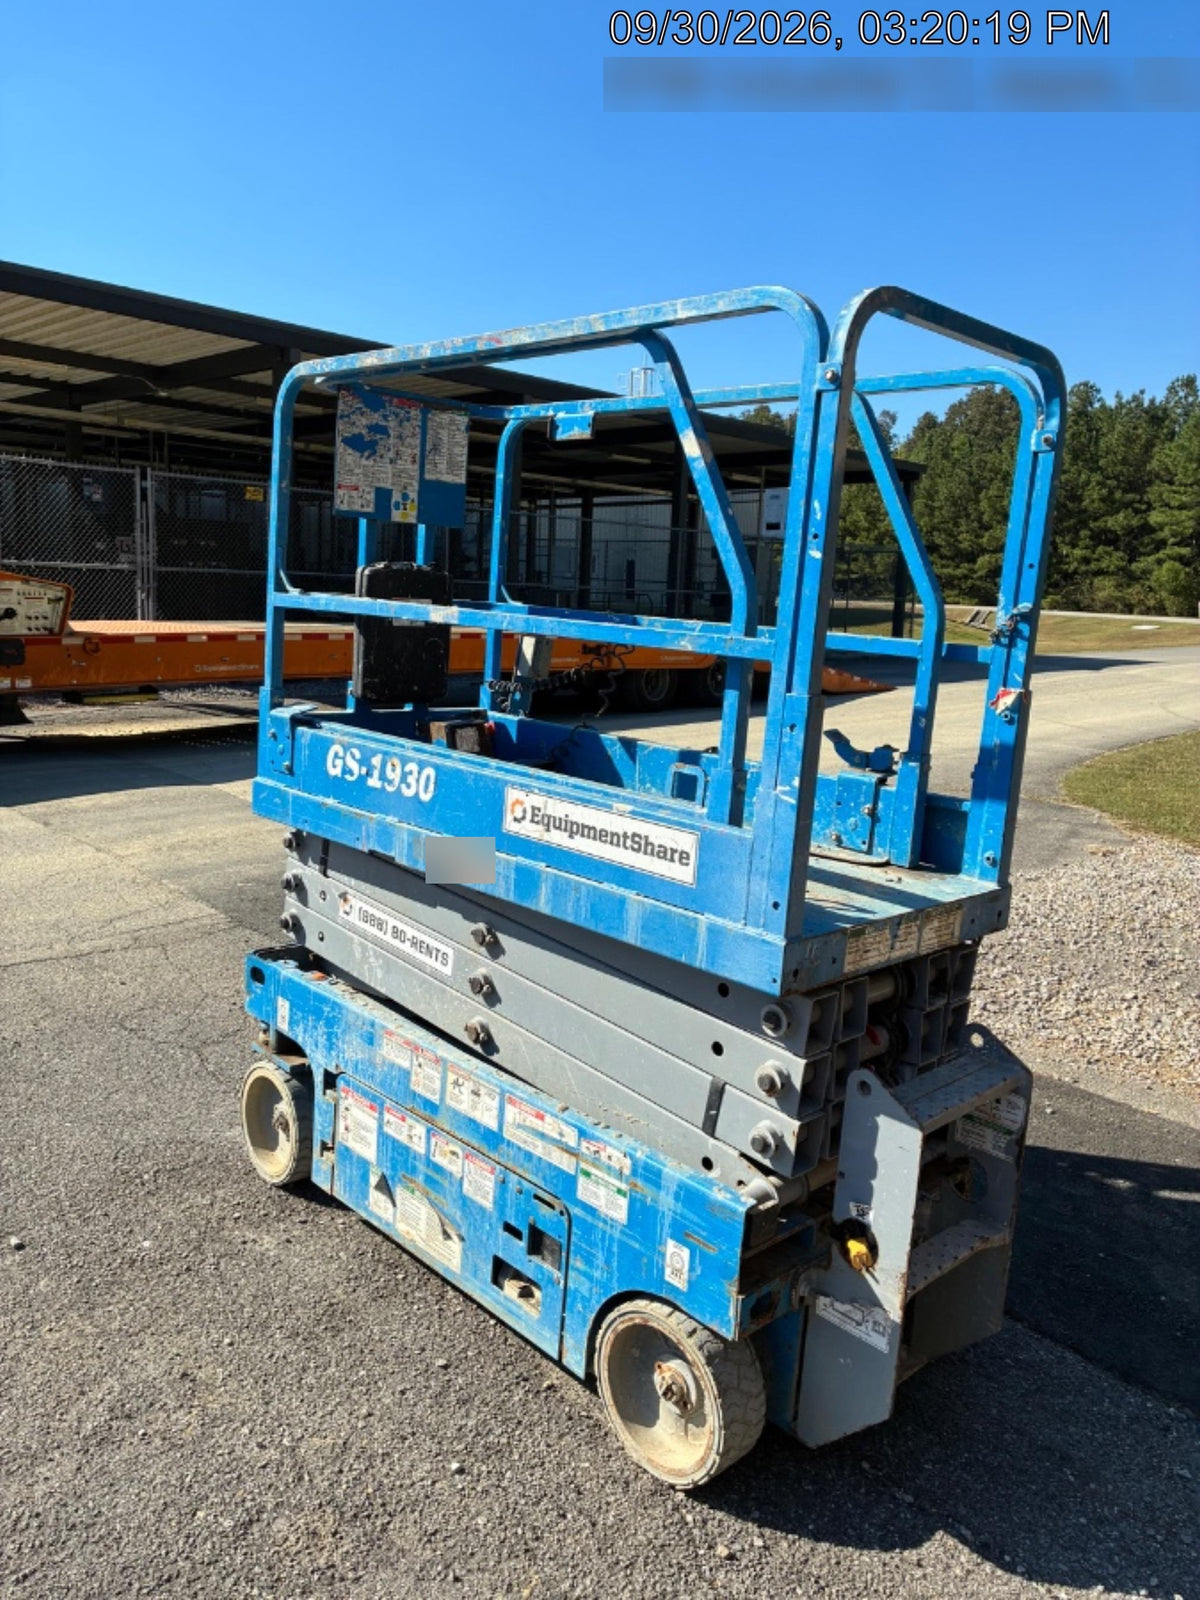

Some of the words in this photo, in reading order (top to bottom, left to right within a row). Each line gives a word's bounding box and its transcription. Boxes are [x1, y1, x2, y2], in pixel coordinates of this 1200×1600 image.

[326, 744, 436, 802] GS-1930
[530, 805, 691, 867] EquipmentShare
[391, 925, 450, 967] 80-RENTS
